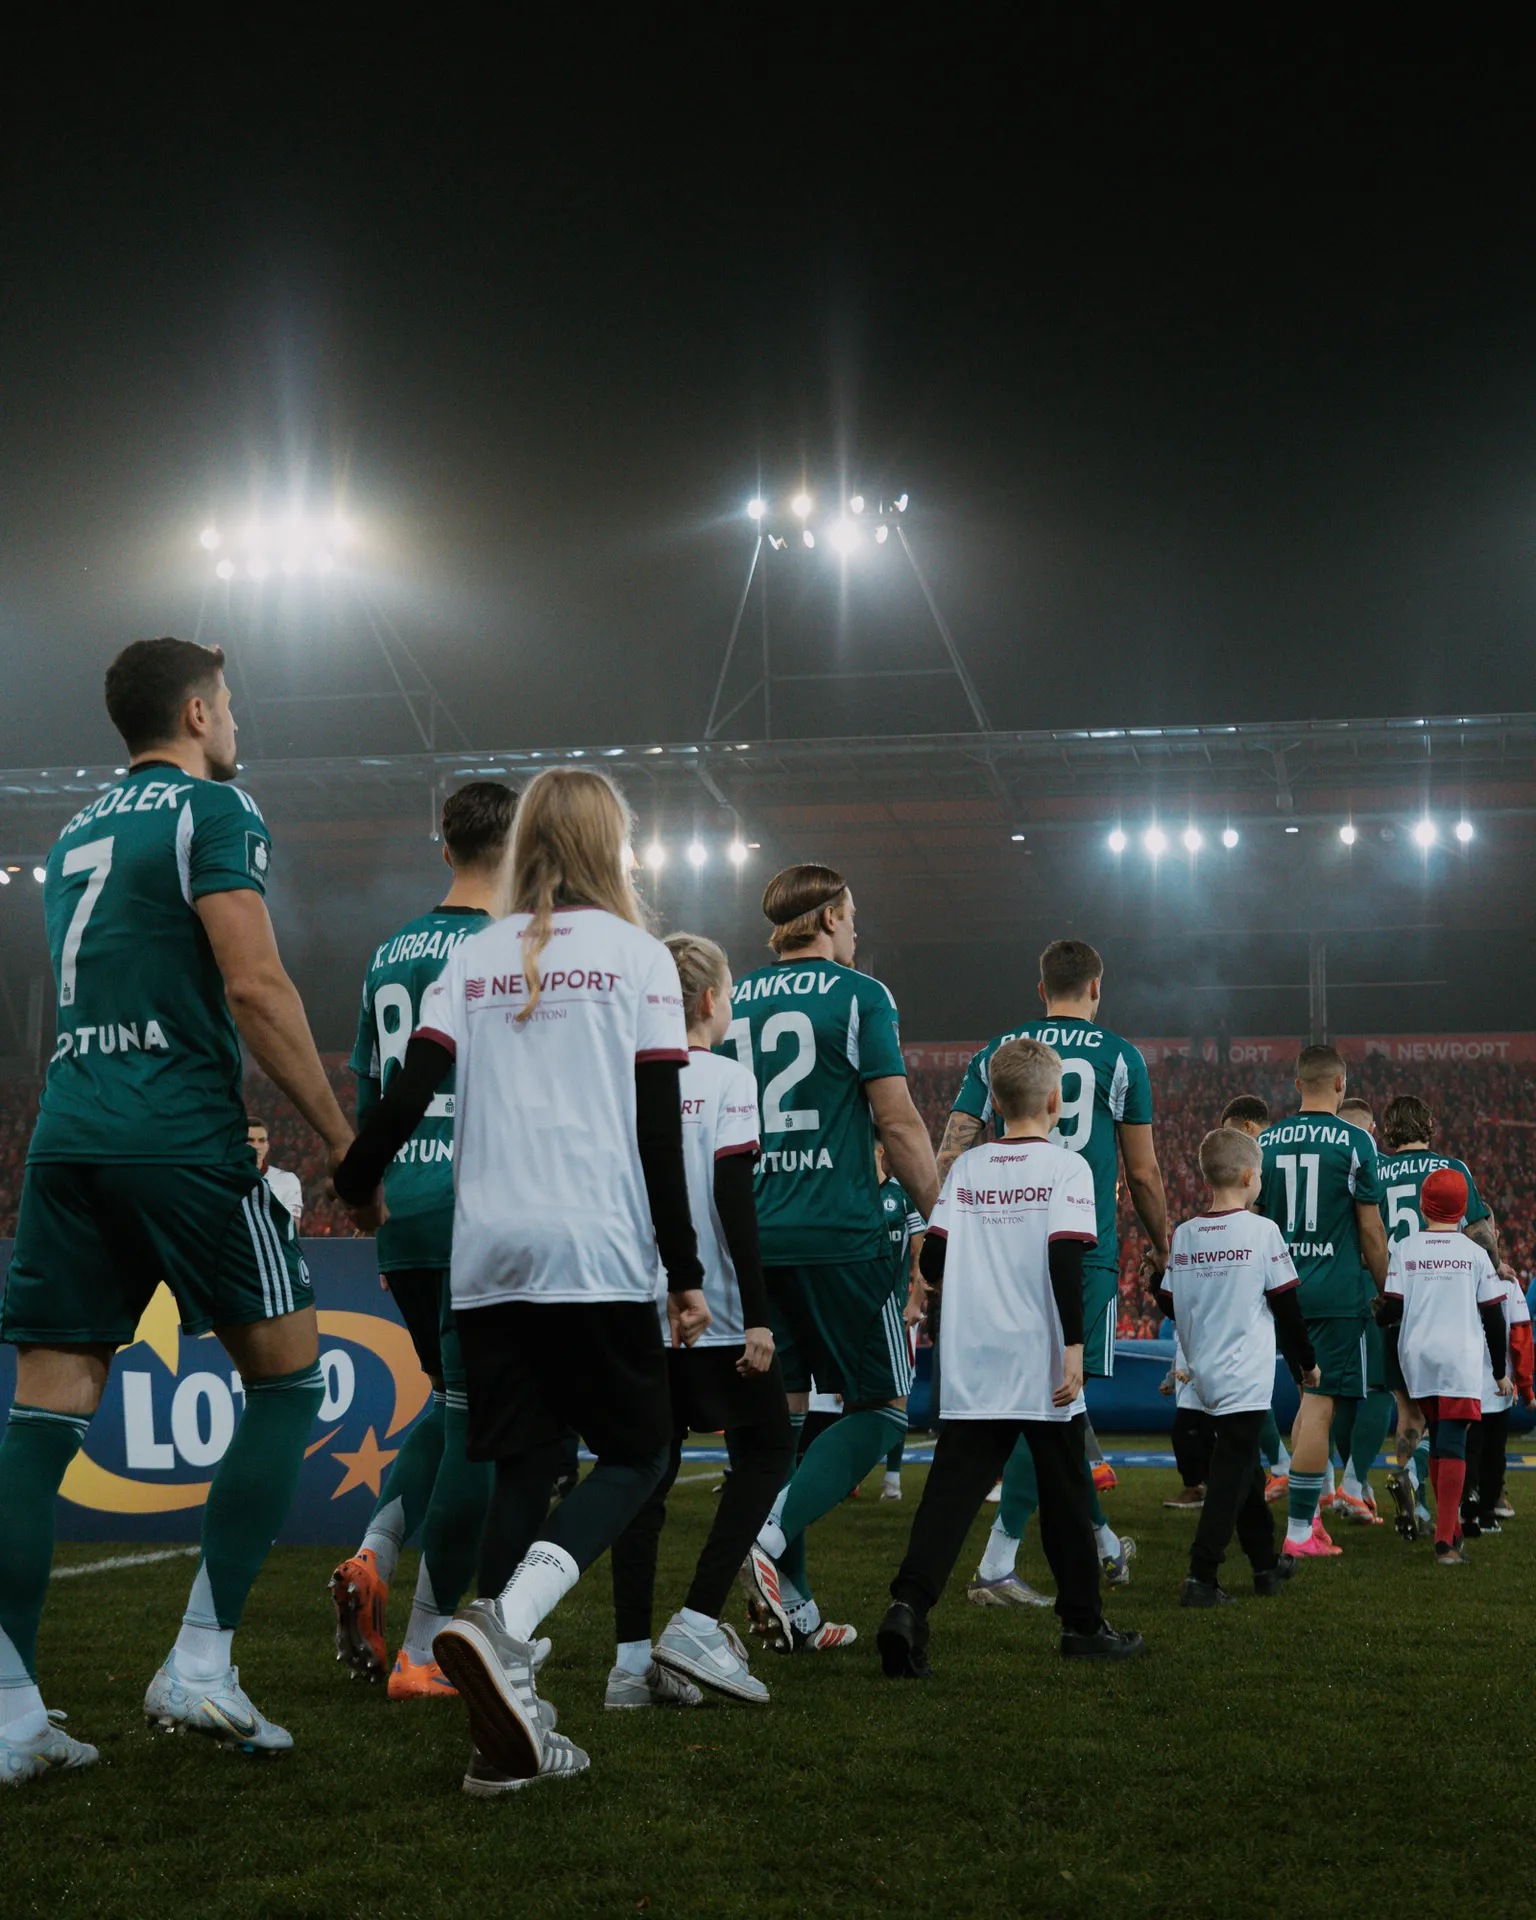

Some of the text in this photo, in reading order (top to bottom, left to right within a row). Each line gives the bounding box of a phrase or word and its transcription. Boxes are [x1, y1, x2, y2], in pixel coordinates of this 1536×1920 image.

[60, 836, 115, 1007] 7
[730, 971, 841, 1005] ANKOV
[1397, 1041, 1511, 1061] NEWPORT
[723, 1011, 820, 1133] 12
[1258, 1124, 1350, 1147] CHODYNA
[1377, 1158, 1449, 1181] NÇALVES
[1275, 1153, 1320, 1232] 11
[1386, 1184, 1419, 1253] 5
[1191, 1249, 1252, 1265] NEWPORT
[1418, 1259, 1472, 1270] NEWPORT
[122, 1349, 355, 1469] LOO
